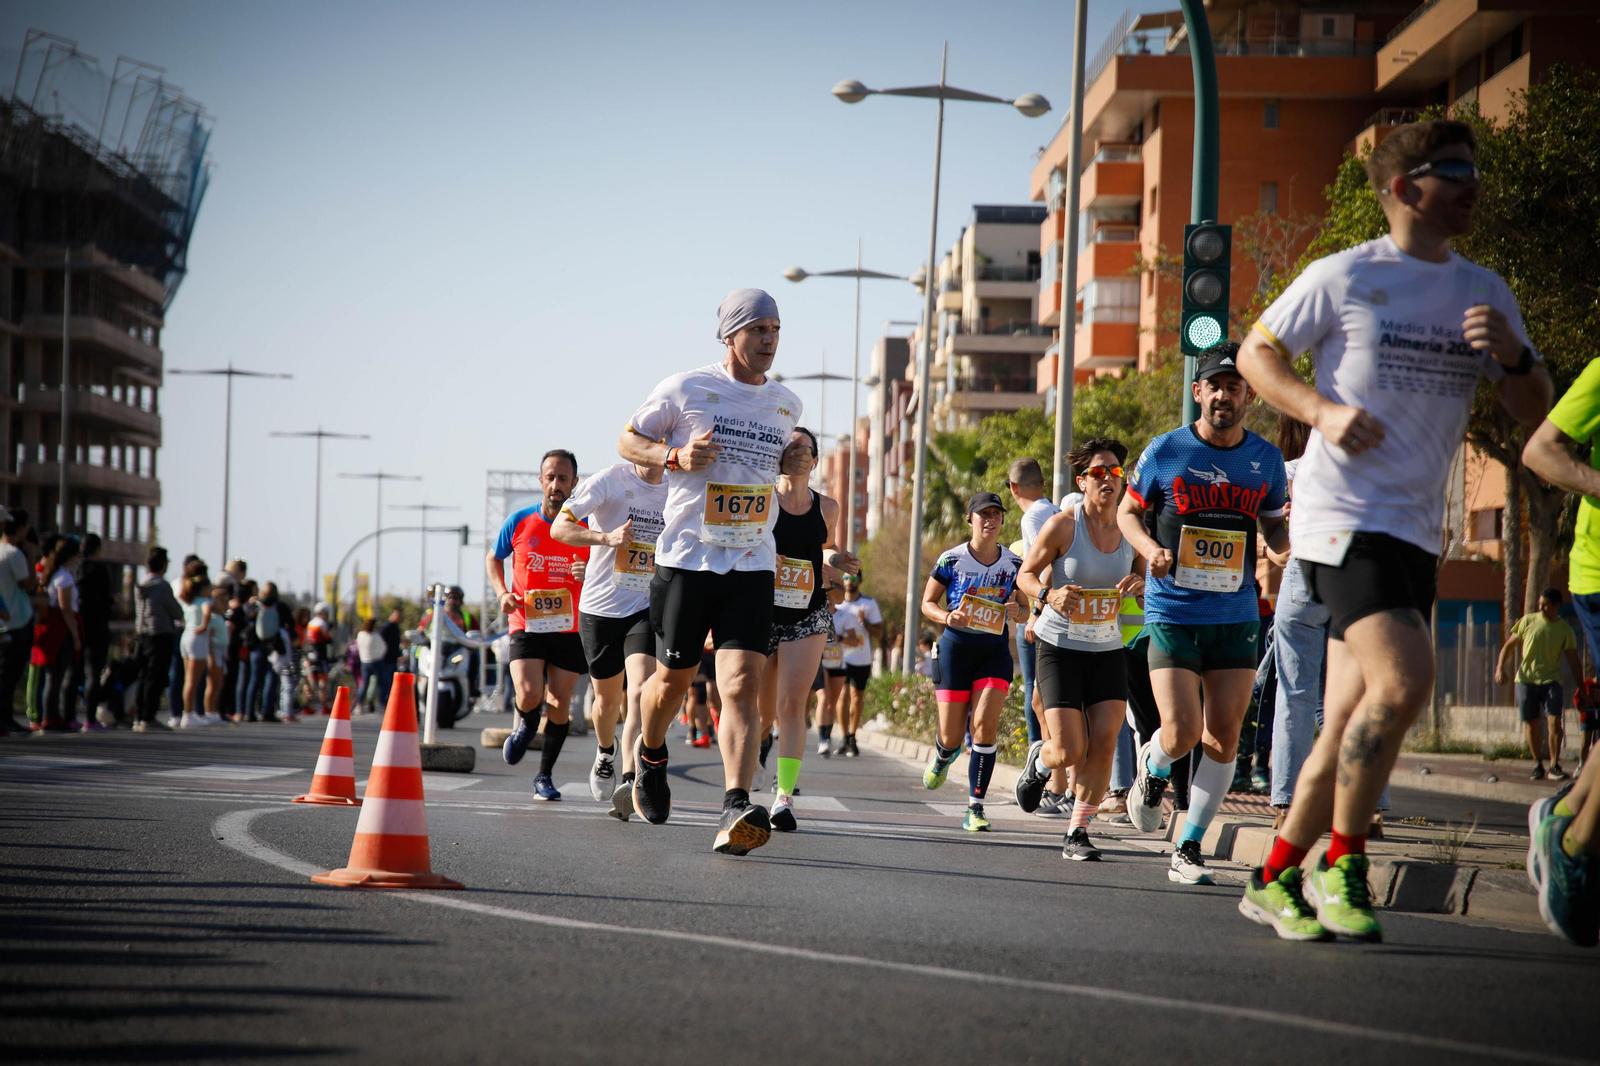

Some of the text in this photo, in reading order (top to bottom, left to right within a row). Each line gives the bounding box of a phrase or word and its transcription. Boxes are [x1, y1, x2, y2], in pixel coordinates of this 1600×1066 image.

[1379, 319, 1424, 335] Medio
[1379, 333, 1443, 354] Almería
[1417, 356, 1440, 367] RUIZ
[713, 415, 785, 436] Medio Maratón
[711, 437, 737, 446] RAMÓN
[739, 441, 754, 449] RUIZ
[712, 424, 784, 447] Almería 2024
[628, 506, 651, 517] Medio
[713, 494, 766, 514] 1678
[627, 513, 659, 525] Almería
[1194, 538, 1234, 560] 900
[548, 555, 569, 563] MEDIO
[533, 597, 563, 611] 899
[1079, 598, 1118, 615] 1157
[965, 603, 1002, 624] 1407
